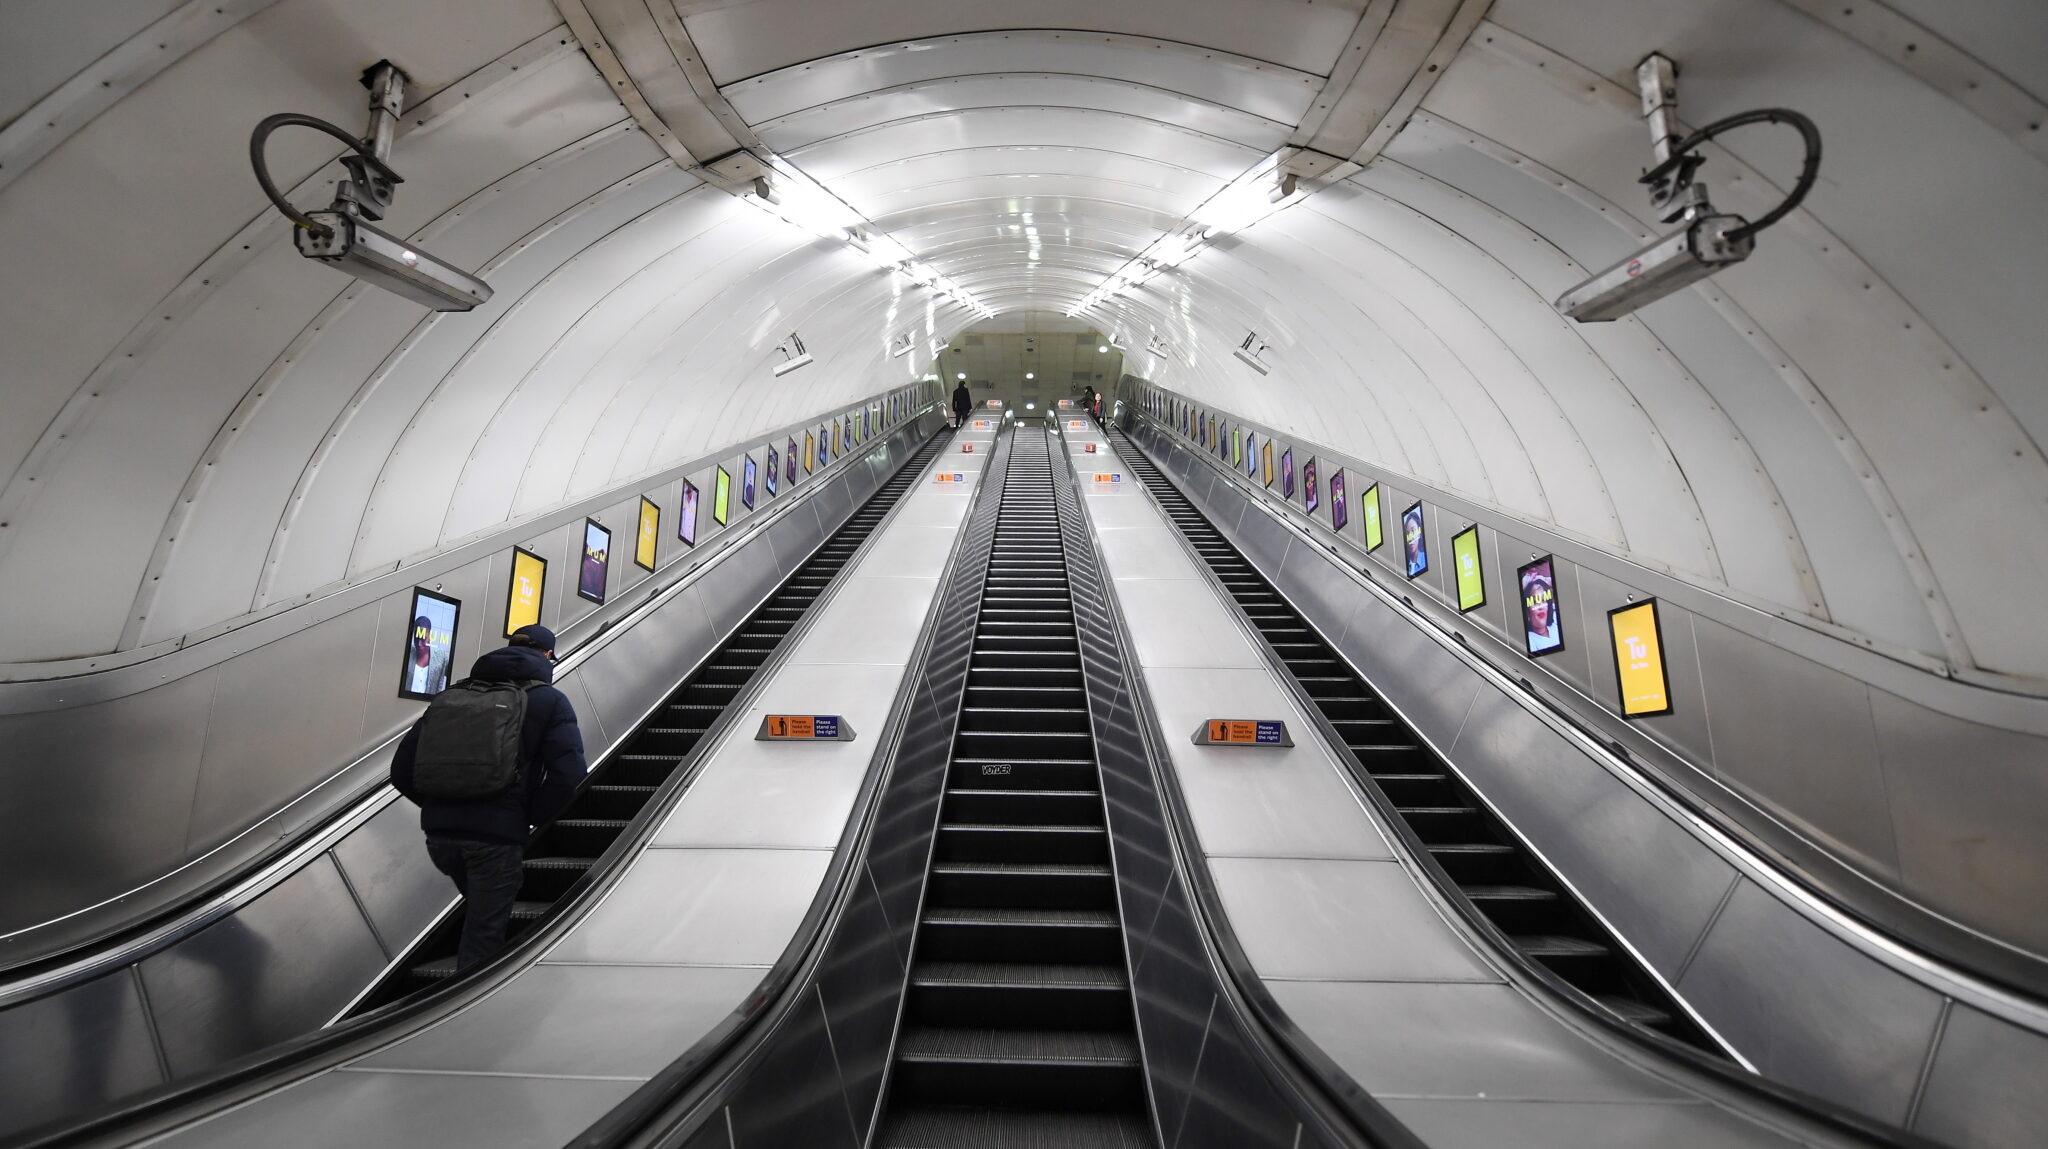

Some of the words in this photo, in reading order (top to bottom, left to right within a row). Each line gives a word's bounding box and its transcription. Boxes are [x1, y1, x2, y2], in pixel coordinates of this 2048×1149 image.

[586, 545, 606, 563] MUM
[1460, 553, 1473, 570] Tu
[519, 576, 534, 598] Tu
[1526, 590, 1552, 607] MUM
[415, 625, 450, 645] MUM
[1624, 636, 1647, 660] Tu
[982, 765, 1011, 775] VOYDER
